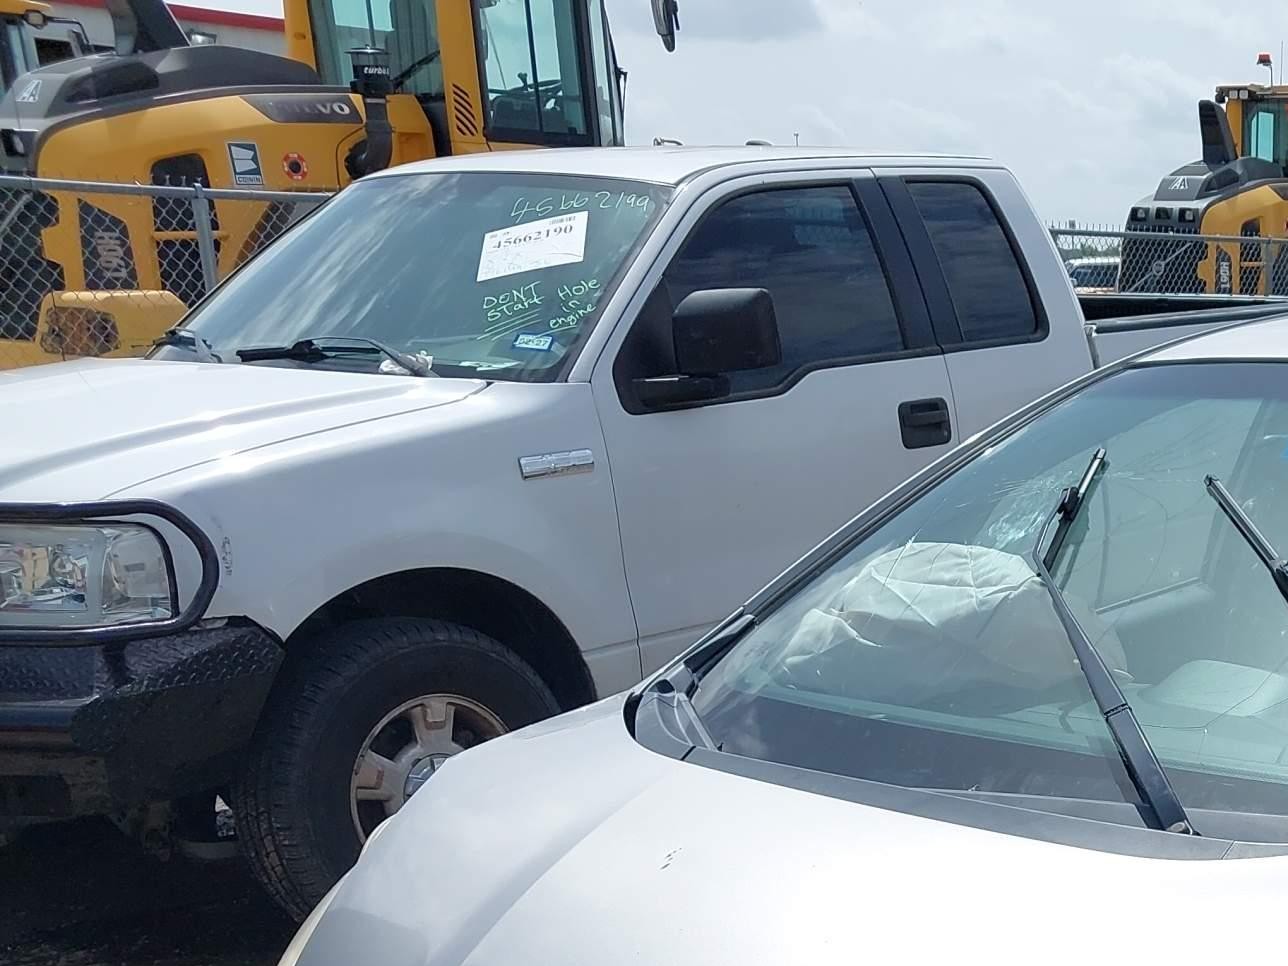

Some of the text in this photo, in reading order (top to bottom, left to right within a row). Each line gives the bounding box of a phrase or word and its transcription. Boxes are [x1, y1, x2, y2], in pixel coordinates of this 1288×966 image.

[492, 223, 574, 250] 45662190
[94, 231, 128, 279] L90H
[482, 281, 541, 309] DONT
[557, 279, 601, 301] Hole
[549, 303, 597, 329] engine
[560, 299, 581, 313] in
